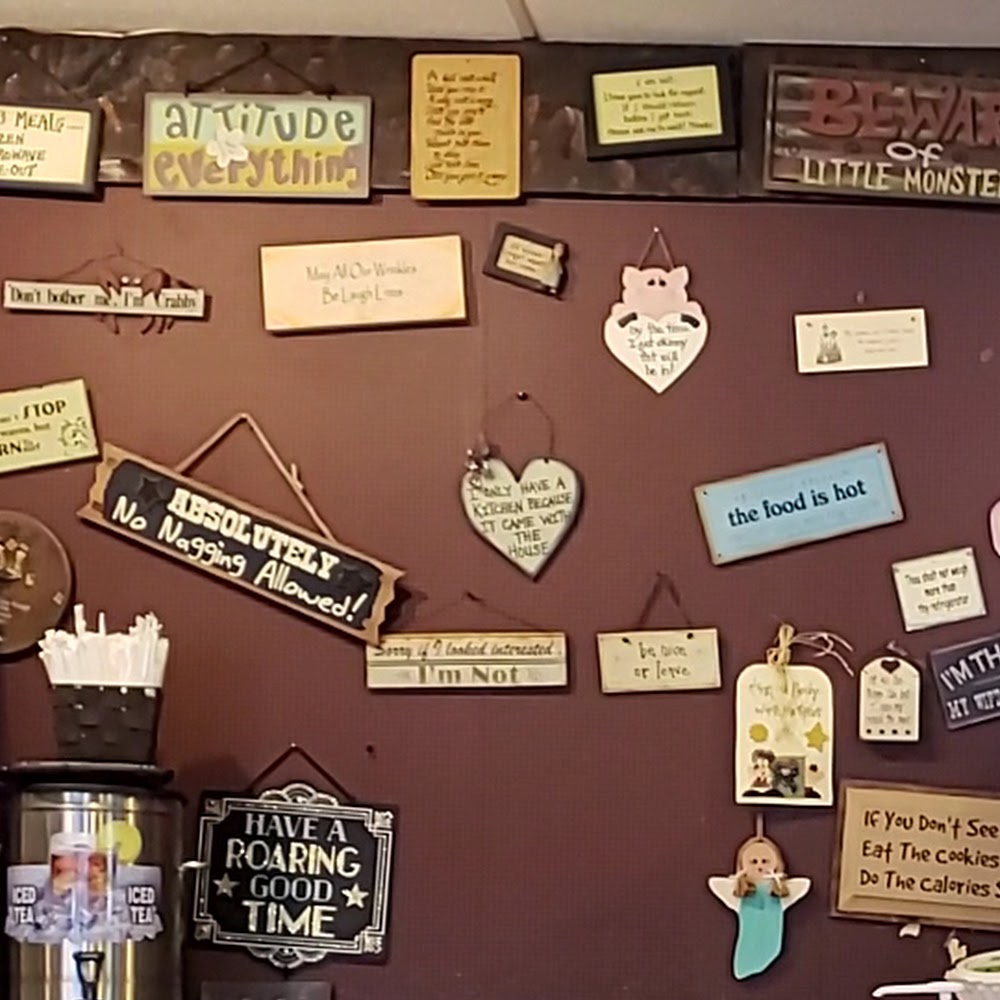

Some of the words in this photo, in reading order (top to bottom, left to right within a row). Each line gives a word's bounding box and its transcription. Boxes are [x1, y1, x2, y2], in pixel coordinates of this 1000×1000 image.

[800, 156, 894, 191] LITTLE
[9, 286, 41, 303] Don't
[23, 400, 67, 420] STOP
[556, 477, 566, 490] A
[727, 507, 760, 528] the
[762, 491, 807, 519] food
[810, 490, 830, 508] is
[832, 480, 868, 502] hot
[166, 488, 340, 581] ABSOLUTELY
[502, 516, 535, 531] CAME
[515, 529, 542, 545] THE
[111, 496, 147, 531] No
[157, 515, 247, 578] Nagging
[254, 560, 369, 622] Allowed!
[508, 541, 549, 559] HOUSE
[418, 666, 462, 685] I'm
[472, 665, 520, 684] Not
[940, 658, 974, 692] I'M
[946, 697, 970, 720] MY
[244, 812, 320, 841] HAVE
[326, 820, 348, 843] A
[864, 810, 881, 828] If
[918, 814, 962, 841] Don't
[966, 818, 1000, 840] See
[224, 838, 362, 878] ROARING
[862, 840, 894, 864] Eat
[900, 842, 931, 863] The
[249, 874, 334, 903] GOOD
[860, 868, 880, 887] Do
[884, 870, 916, 892] The
[12, 886, 37, 905] ICED
[128, 886, 156, 905] ICED
[14, 907, 35, 924] TEA
[130, 907, 153, 924] TEA
[242, 900, 338, 939] TIME
